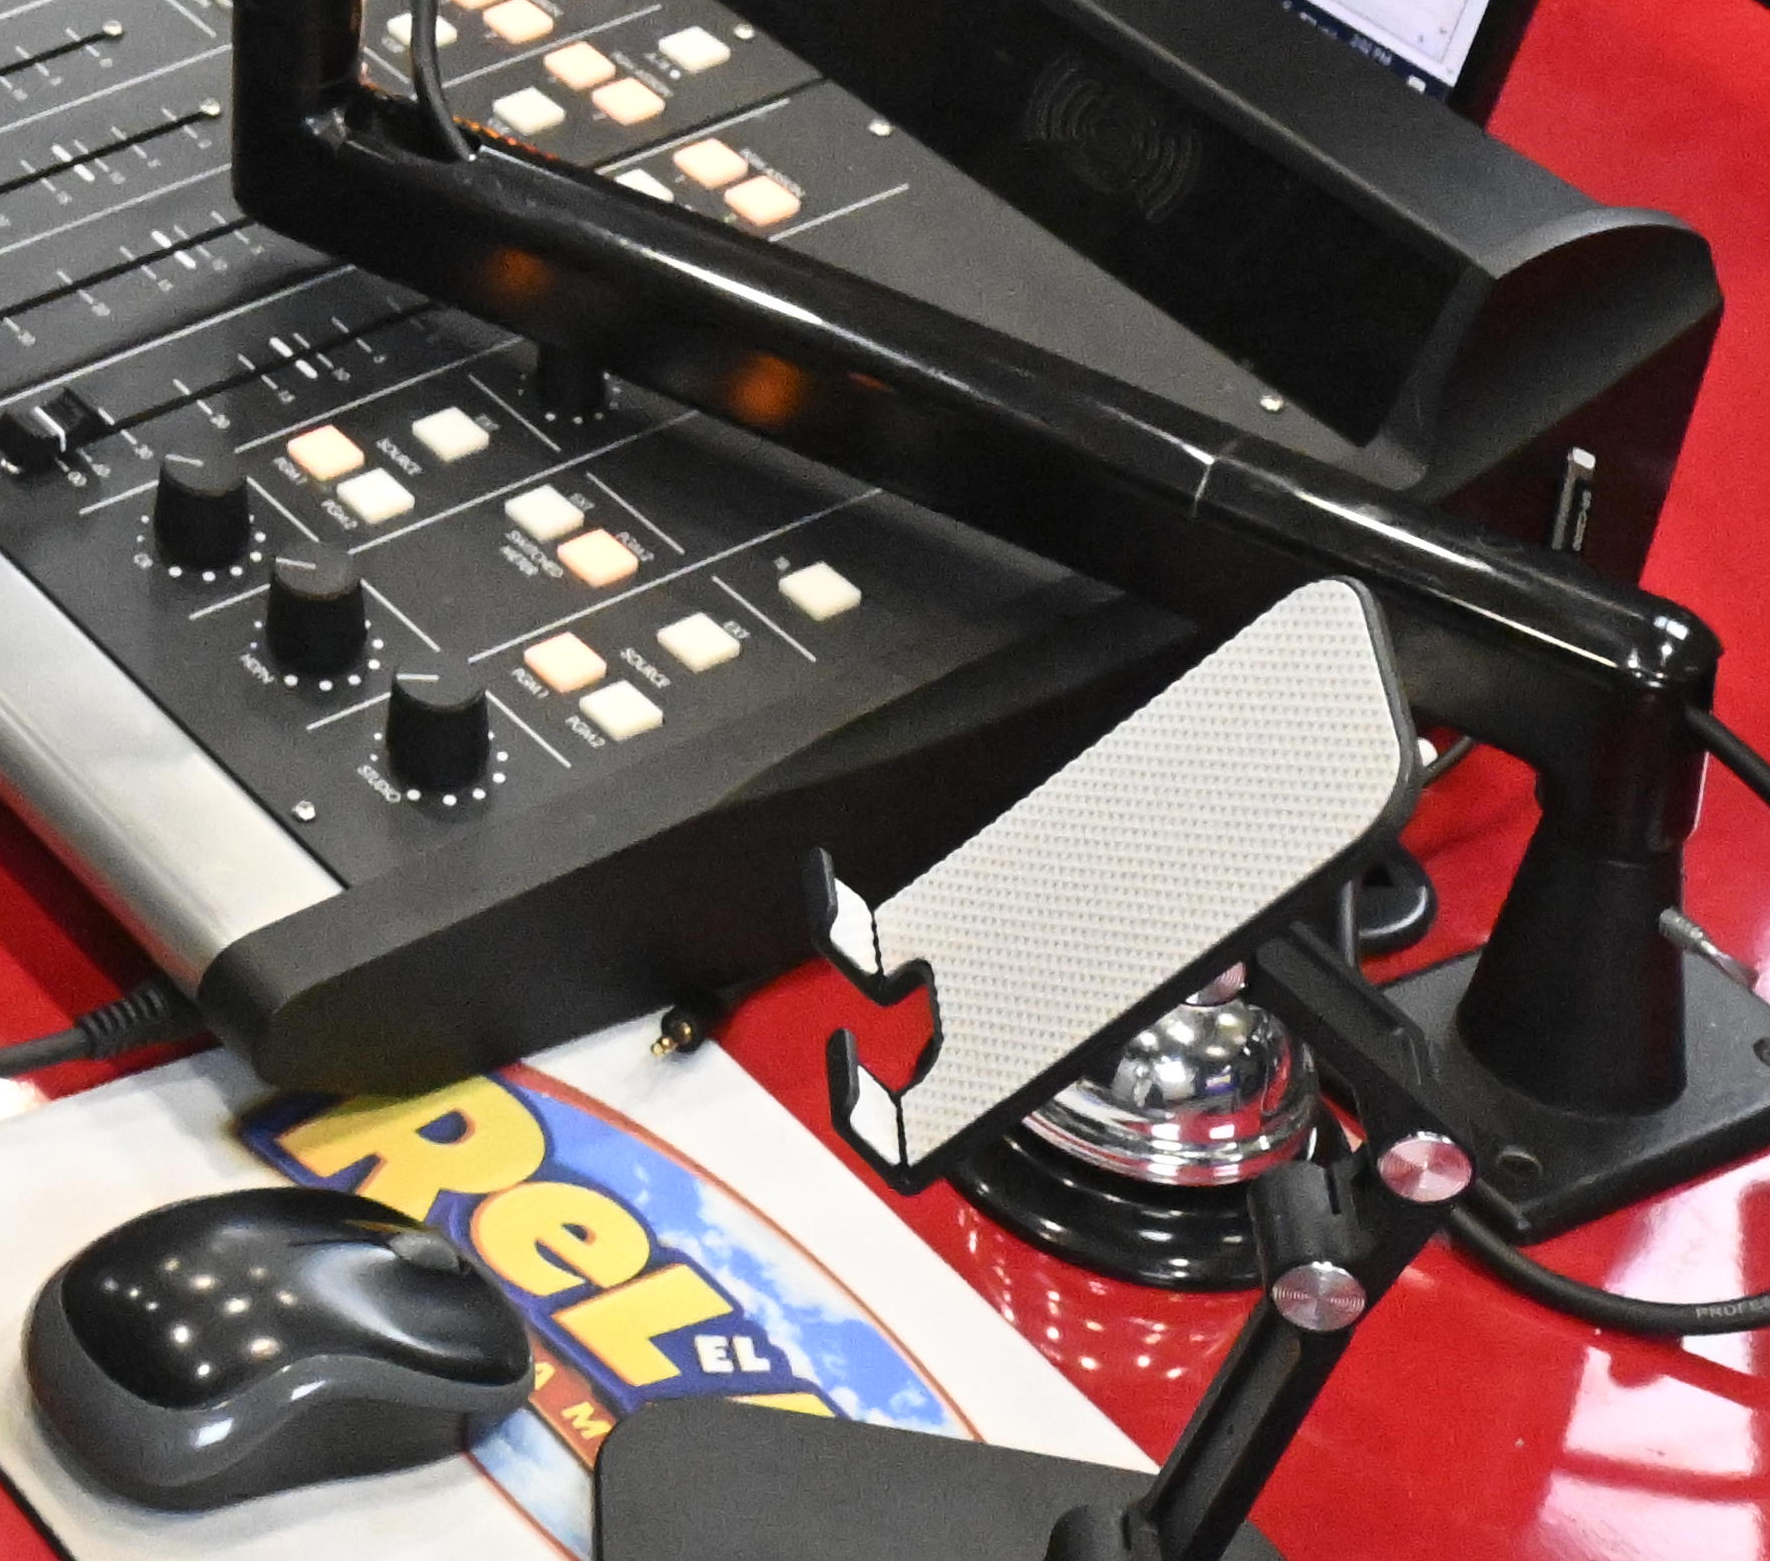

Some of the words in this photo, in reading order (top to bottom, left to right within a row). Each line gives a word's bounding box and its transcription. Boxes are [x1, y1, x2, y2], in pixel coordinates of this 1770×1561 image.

[375, 437, 423, 475] SOURCE
[511, 667, 550, 699] PGM1
[620, 647, 671, 688] SOURCE
[564, 714, 606, 749] PGM2
[357, 764, 402, 803] STUDIO
[694, 1335, 772, 1373] EL
